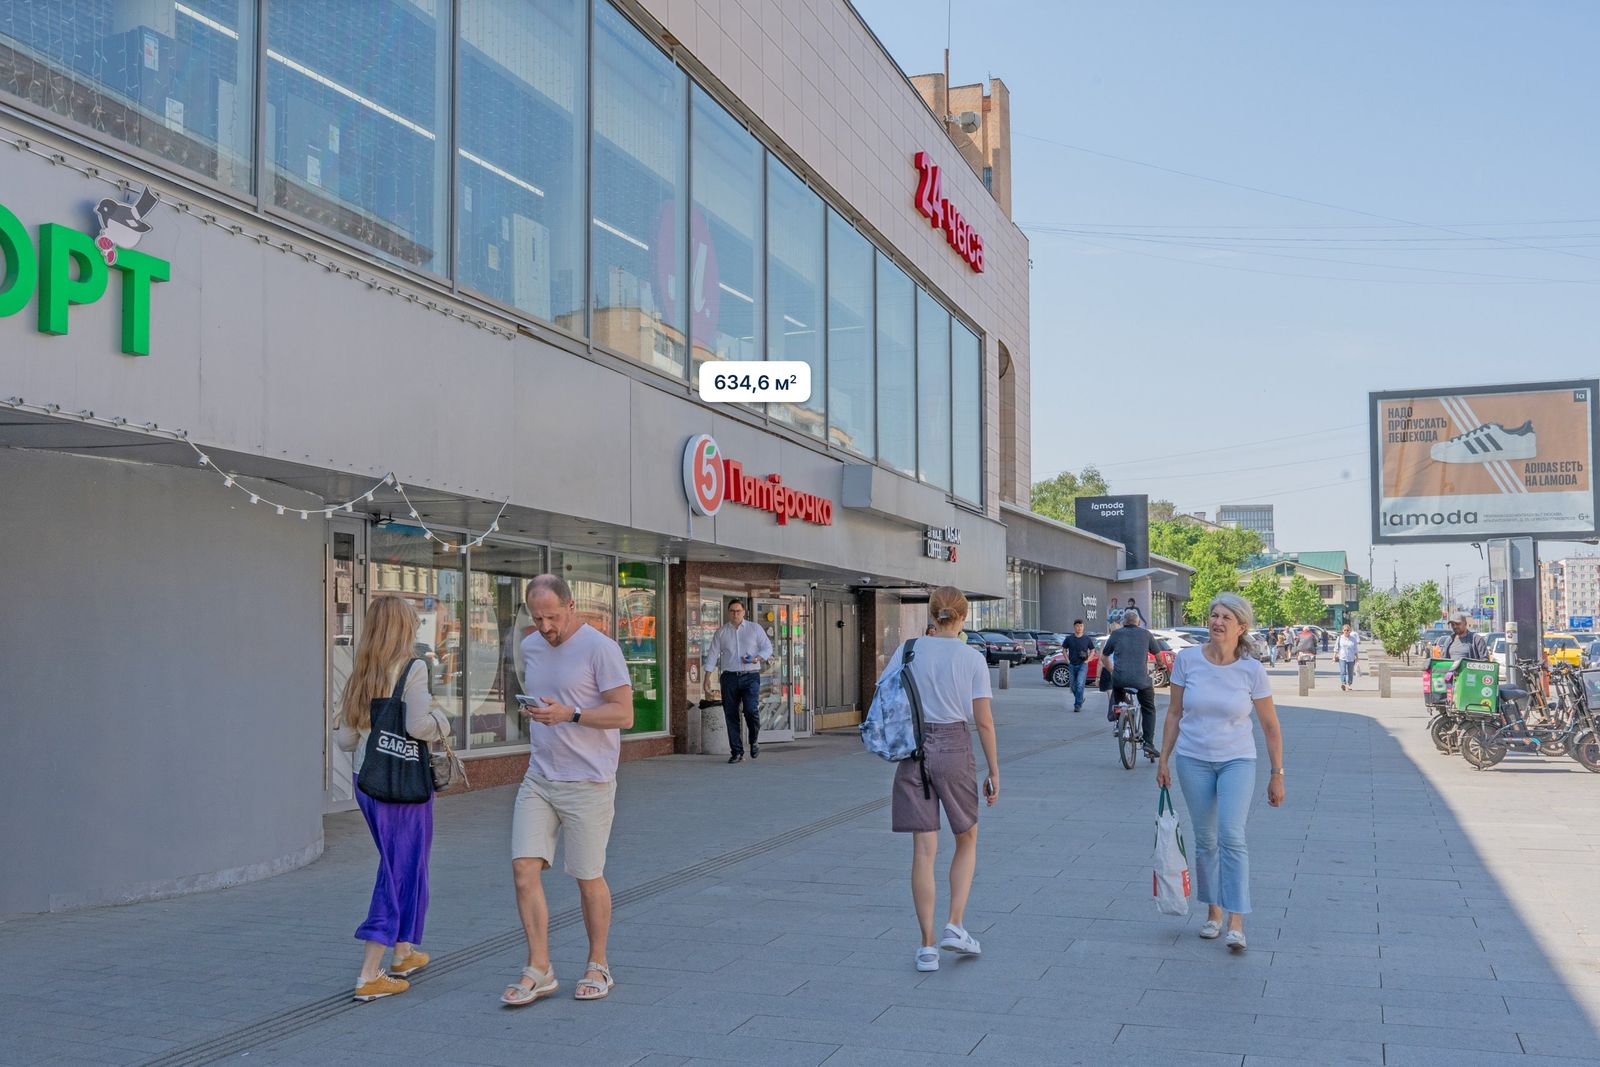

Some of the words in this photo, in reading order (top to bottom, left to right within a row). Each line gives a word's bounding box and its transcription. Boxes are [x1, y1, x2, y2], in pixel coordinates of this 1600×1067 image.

[915, 151, 943, 229] 24
[942, 199, 985, 273] часа
[1388, 407, 1413, 419] НАДО
[1388, 417, 1447, 431] ПРОПУСКАТЬ
[1388, 430, 1438, 443] ПЕШЕХОДА
[1524, 462, 1558, 474] ADIDAS
[1560, 461, 1583, 473] ЕСТЬ
[1525, 475, 1538, 486] НА
[1539, 474, 1578, 486] LAMODA
[723, 459, 833, 526] Пятёрочка
[1091, 502, 1124, 510] lamoda
[1383, 509, 1478, 527] lamoda
[1578, 513, 1590, 521] 6+
